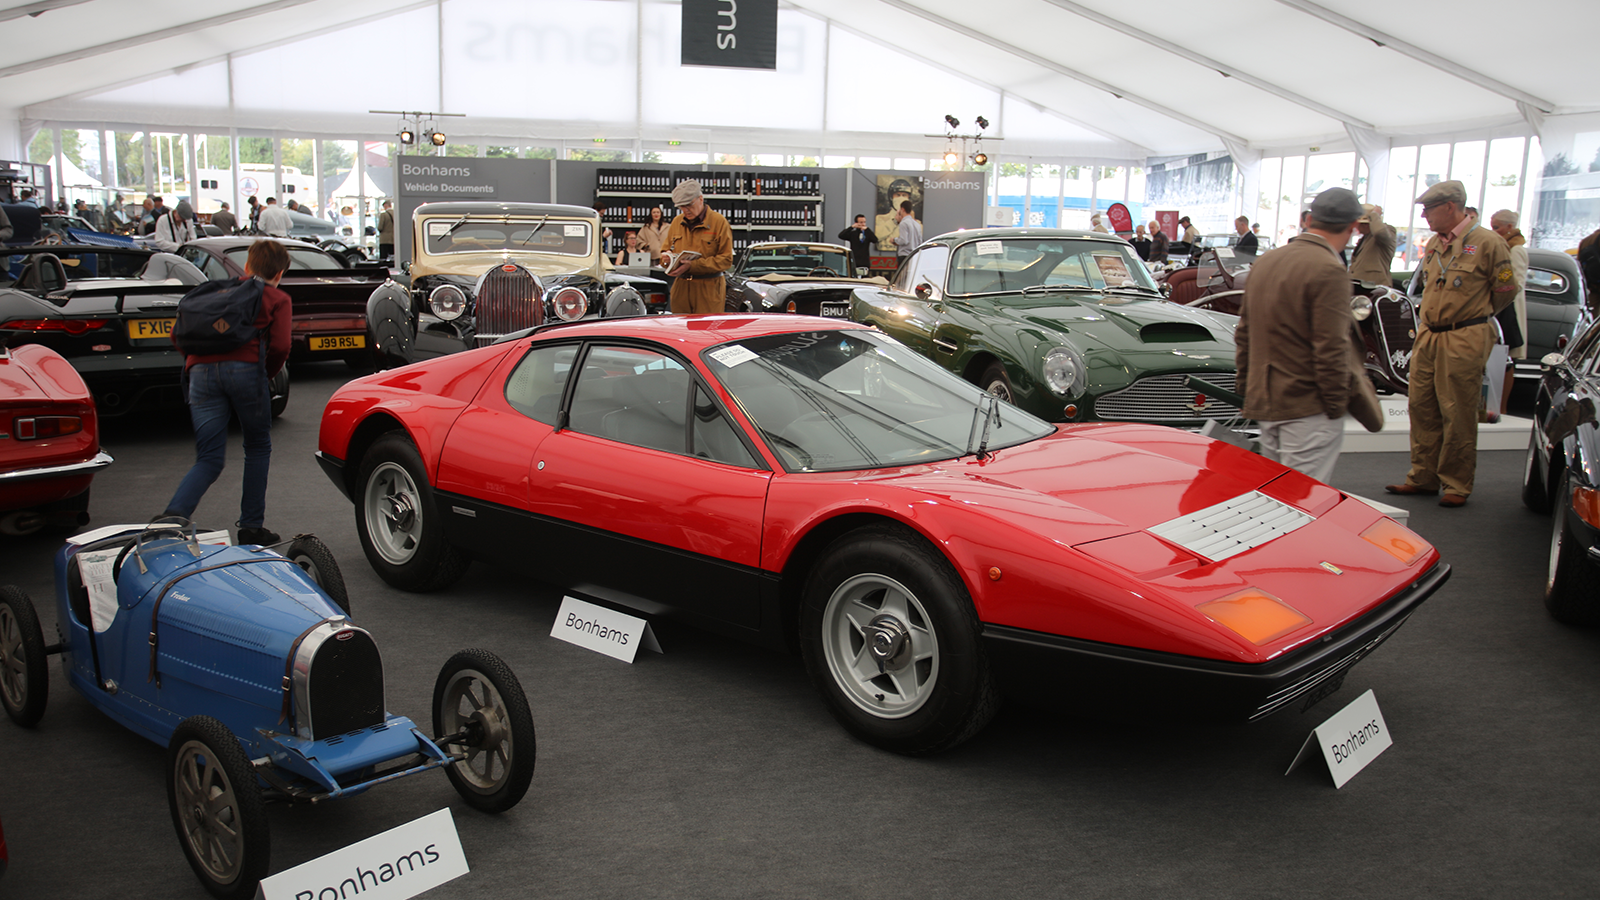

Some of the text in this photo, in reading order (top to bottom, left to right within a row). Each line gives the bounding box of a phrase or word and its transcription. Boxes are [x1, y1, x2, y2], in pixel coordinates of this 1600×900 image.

[402, 163, 470, 177] Bonhams
[404, 182, 494, 193] Vehicle Documents
[923, 178, 980, 191] Bonhams
[823, 307, 844, 316] BMU
[138, 320, 172, 335] FX16
[318, 337, 358, 348] J99 RSL
[565, 612, 630, 645] Bonhams
[1331, 719, 1380, 764] Bonhams
